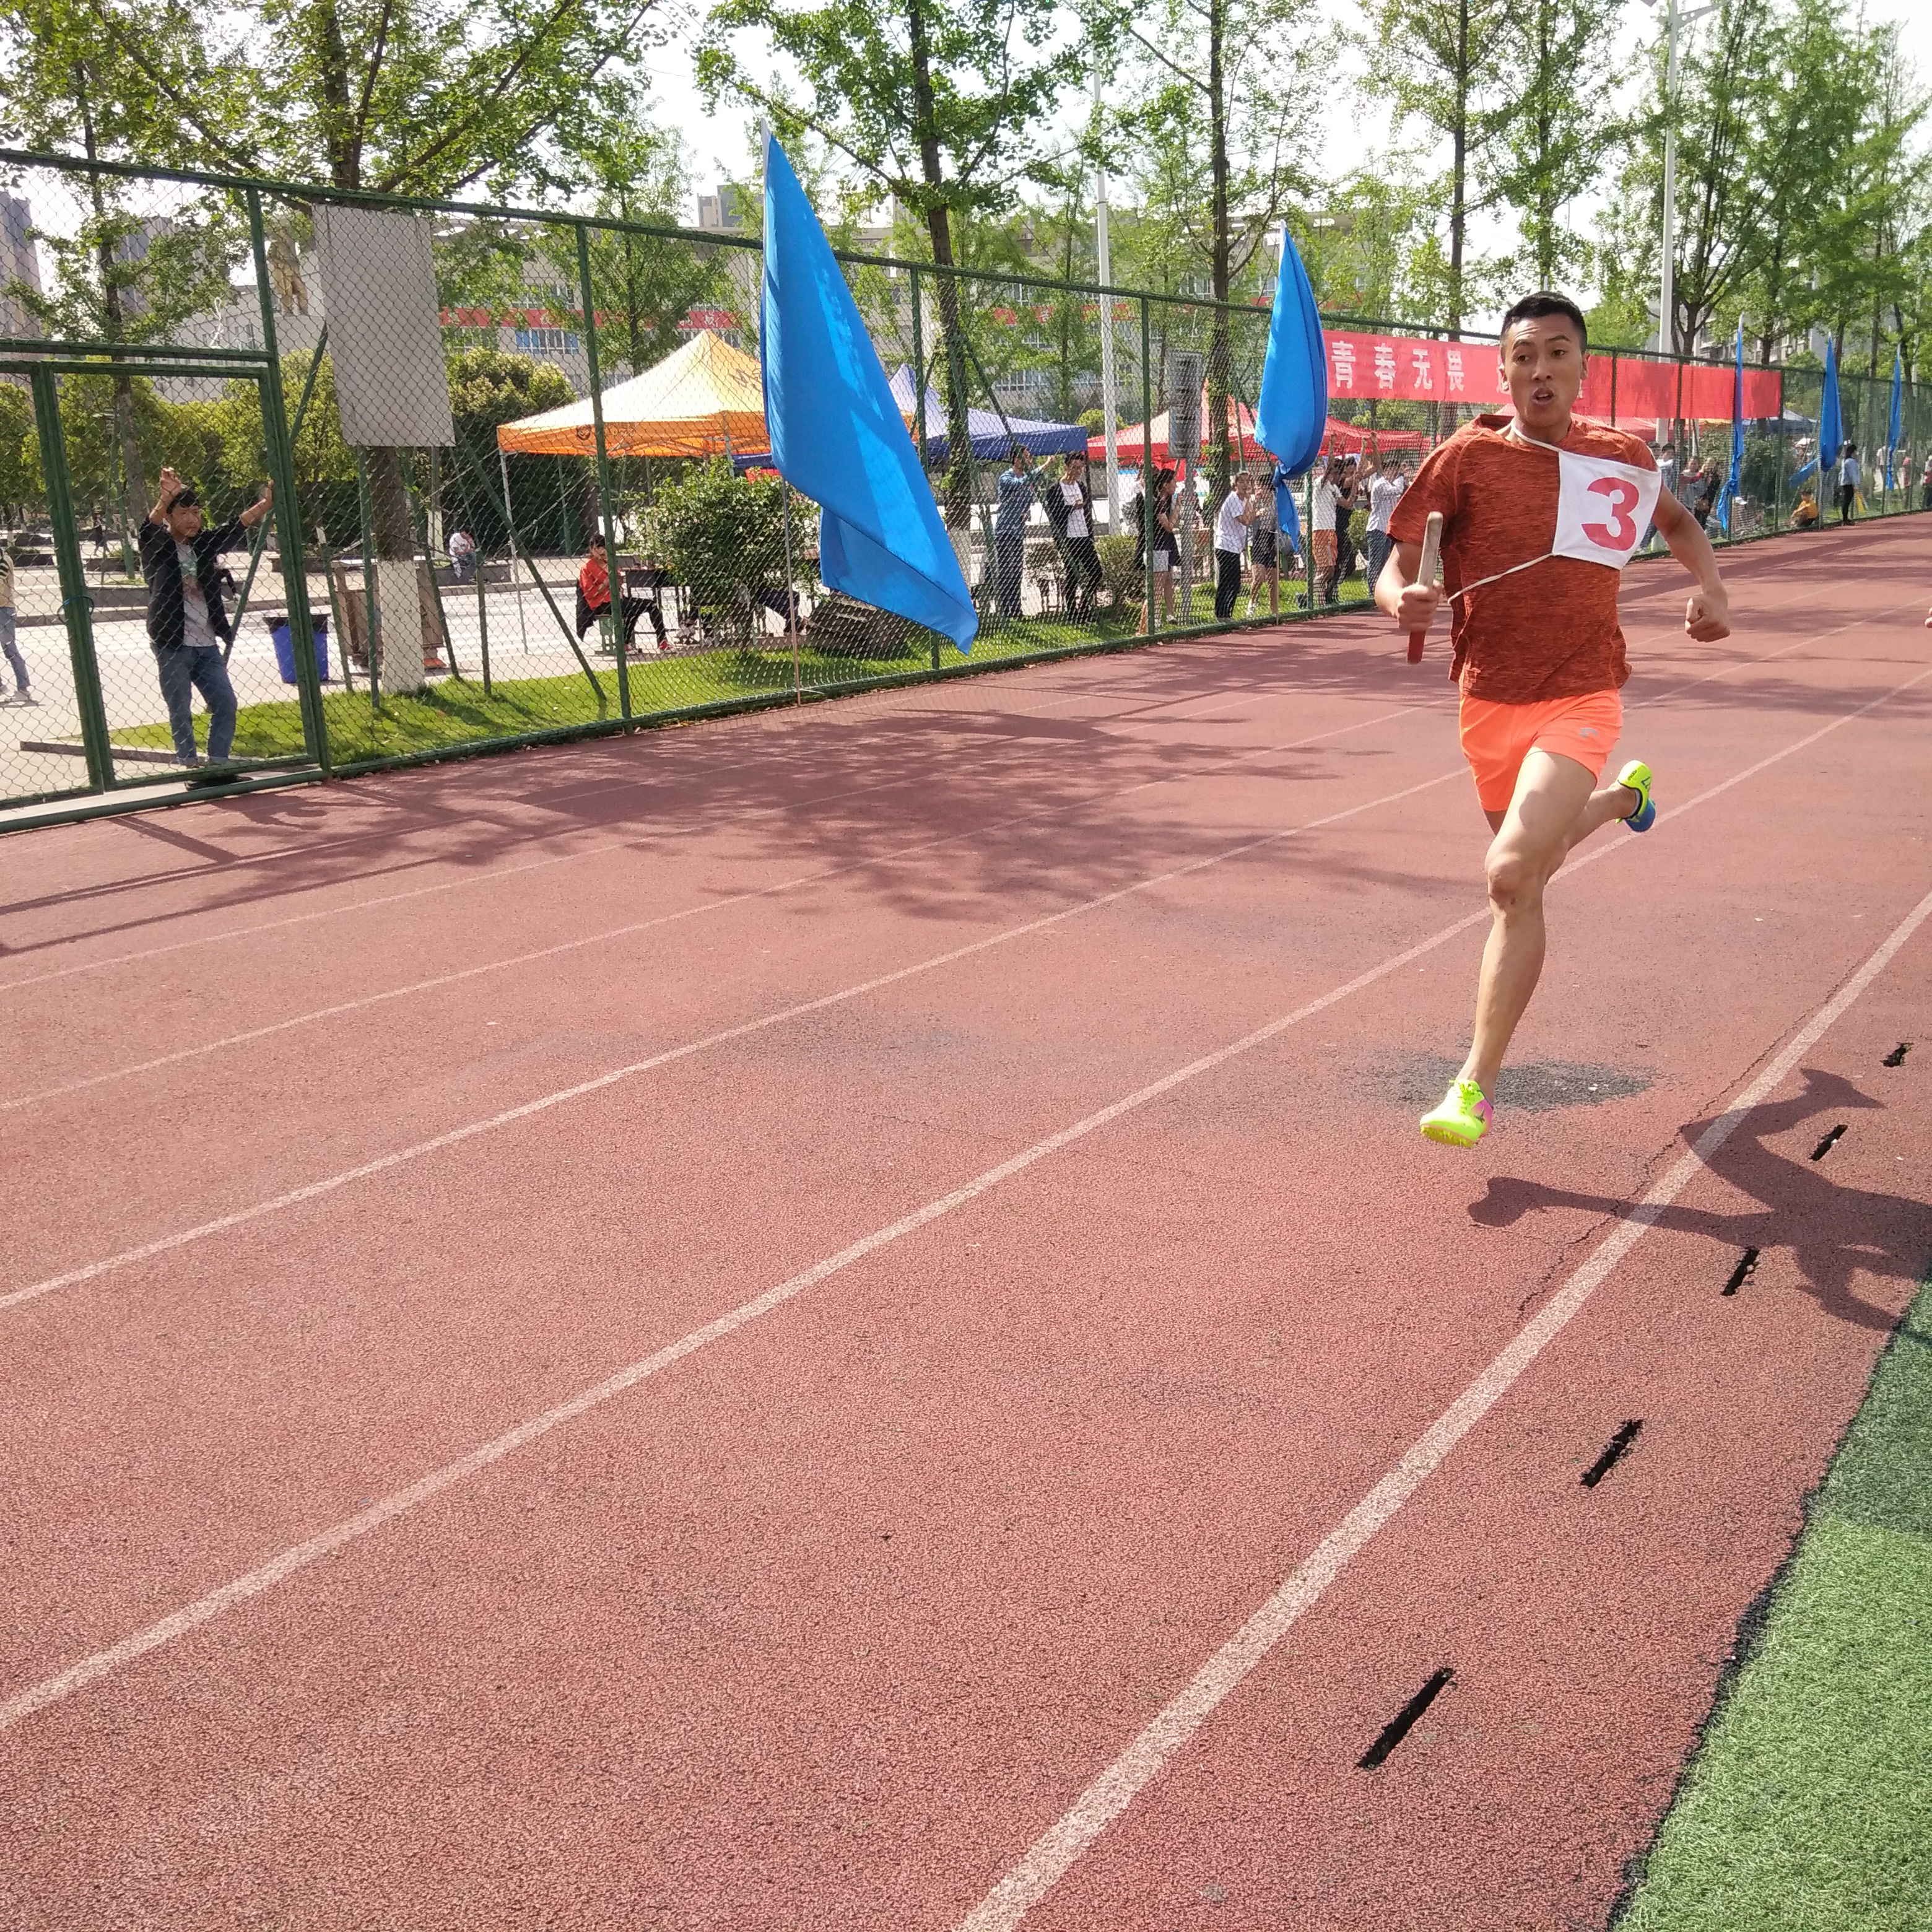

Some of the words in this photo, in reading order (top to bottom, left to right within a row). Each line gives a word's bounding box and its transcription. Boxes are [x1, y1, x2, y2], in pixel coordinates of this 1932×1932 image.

[1331, 340, 1465, 392] 青春无畏
[1581, 477, 1639, 551] 3
